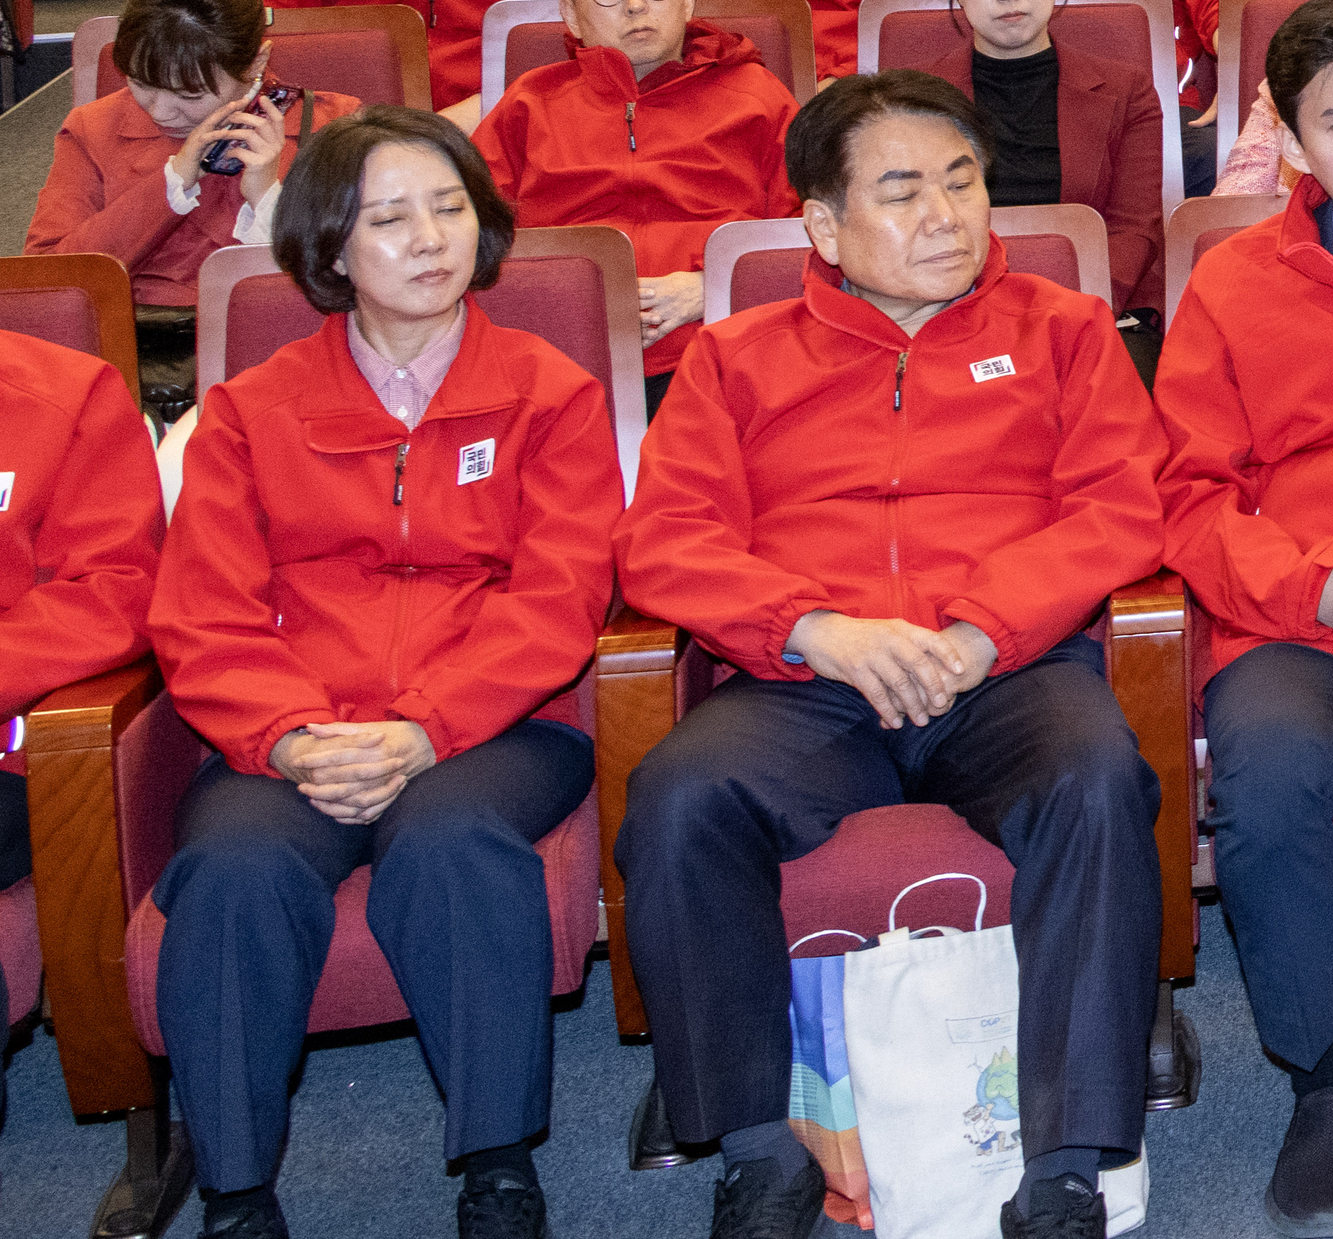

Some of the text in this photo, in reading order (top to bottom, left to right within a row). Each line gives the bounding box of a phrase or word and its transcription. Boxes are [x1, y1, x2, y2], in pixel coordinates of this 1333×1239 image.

[983, 360, 1003, 370] 국민
[984, 366, 1005, 376] 의힘
[467, 448, 486, 462] 국민
[466, 459, 487, 475] 의힘
